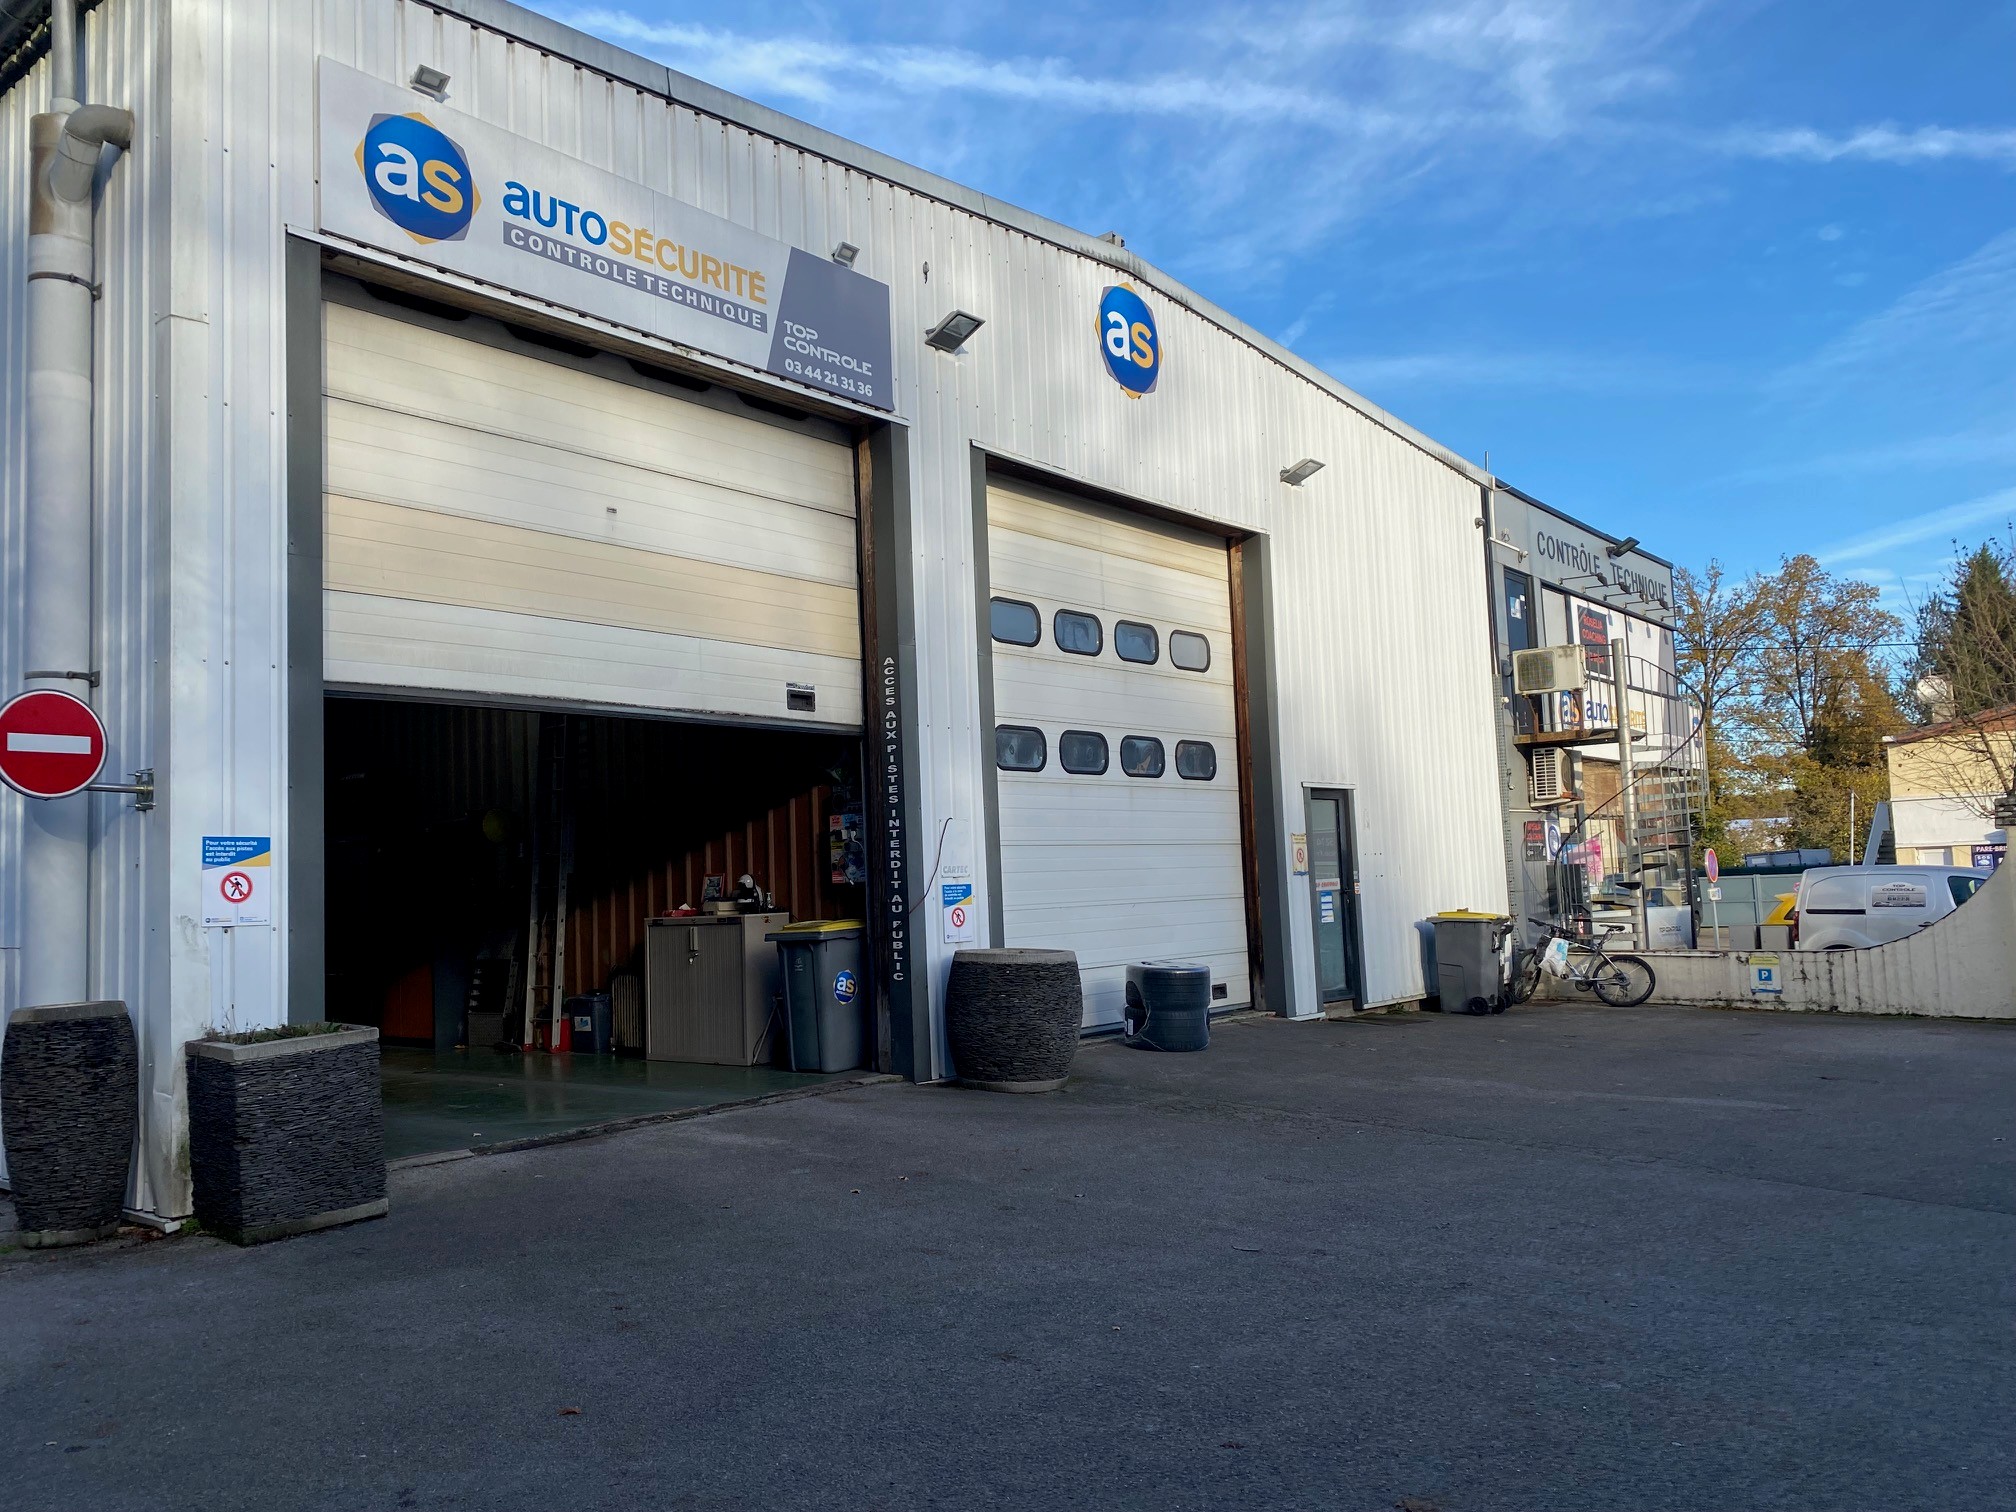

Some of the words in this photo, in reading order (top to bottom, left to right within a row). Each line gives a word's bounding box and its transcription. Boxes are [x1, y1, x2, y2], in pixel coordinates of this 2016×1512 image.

[374, 143, 464, 214] as
[510, 228, 637, 285] CONTROLE
[643, 274, 762, 328] TECHNIQUE
[784, 320, 818, 340] TOP
[1107, 311, 1154, 368] as
[784, 336, 872, 376] CONTROLE
[785, 358, 802, 374] 03
[804, 365, 822, 381] 44
[824, 371, 839, 386] 21
[841, 376, 855, 392] 31
[857, 382, 873, 397] 36
[1537, 531, 1600, 575] CONTRÔLE
[883, 657, 895, 706] ACCES
[885, 710, 897, 739] AUX
[887, 745, 899, 804] PISTES
[889, 809, 901, 889] INTERDIT
[943, 866, 969, 874] CARTEC
[891, 895, 903, 913] AU
[892, 921, 904, 980] PUBLIC
[837, 976, 855, 993] as
